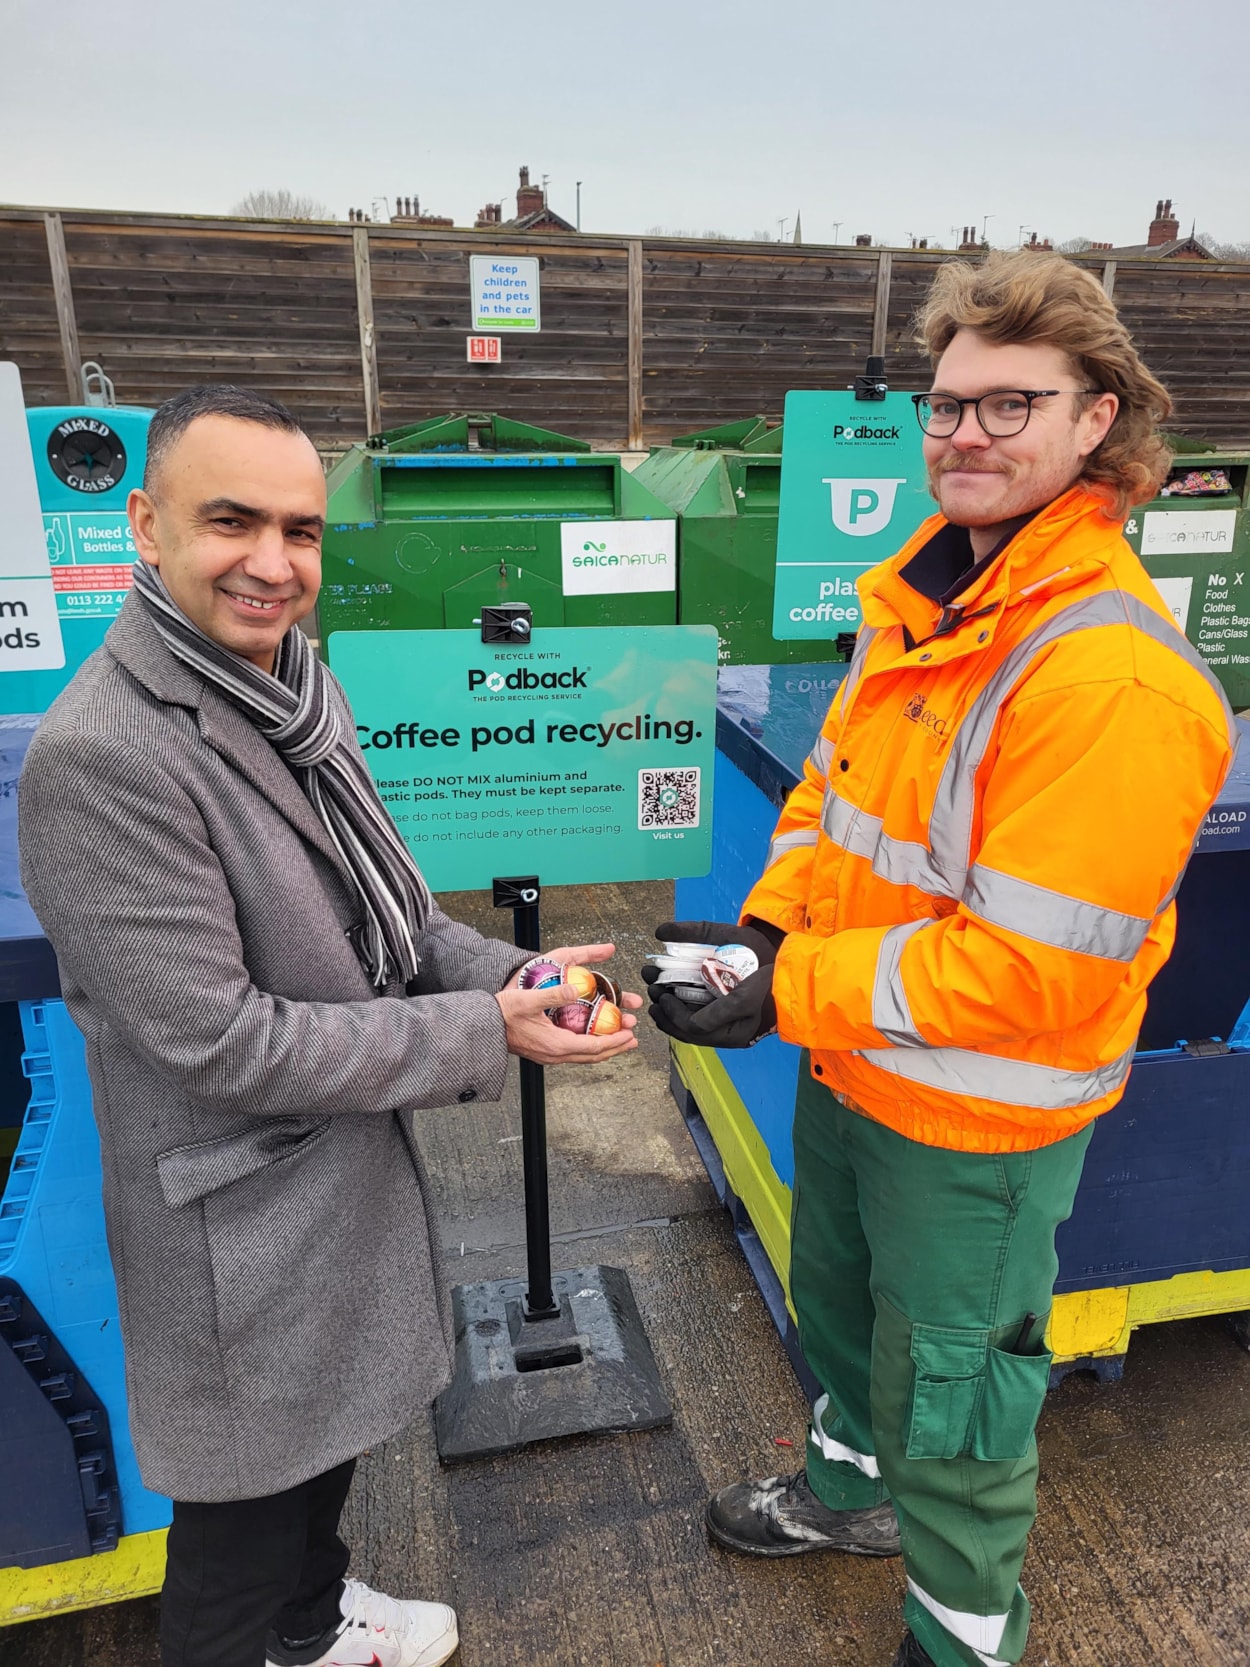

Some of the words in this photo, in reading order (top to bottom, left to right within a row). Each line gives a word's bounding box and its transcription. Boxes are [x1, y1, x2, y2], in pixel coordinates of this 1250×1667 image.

[492, 264, 518, 275] Keep
[484, 278, 527, 287] children
[482, 291, 501, 300] and
[506, 292, 530, 302] pets
[480, 304, 490, 313] in
[494, 304, 512, 314] the
[58, 418, 110, 438] MIXED
[834, 425, 900, 440] Podback
[67, 474, 115, 491] GLASS
[78, 526, 122, 540] Mixed
[83, 541, 124, 552] Bottles
[1208, 574, 1227, 586] No
[66, 595, 92, 605] 0113
[94, 594, 114, 604] 222
[1205, 590, 1228, 599] Food
[789, 603, 859, 621] coffee
[1203, 603, 1236, 613] Clothes
[1201, 616, 1229, 626] Plastic
[0, 627, 41, 649] ds
[1199, 629, 1248, 639] Cans/Glass
[1196, 642, 1226, 652] Plastic
[494, 653, 534, 661] RECYCLE
[537, 652, 561, 660] WITH
[1204, 655, 1229, 664] eneral
[1231, 654, 1250, 664] Was
[468, 666, 588, 692] Podback
[356, 722, 460, 750] Coffee
[471, 718, 535, 752] pod
[547, 714, 703, 747] recycling.
[376, 778, 409, 789] lease
[413, 777, 433, 787] DO
[437, 776, 464, 786] NOT
[467, 774, 491, 785] MIX
[494, 772, 561, 784] aluminium
[564, 771, 588, 781] and
[381, 791, 411, 802] astic
[414, 790, 448, 802] pods.
[451, 789, 482, 800] They
[485, 787, 517, 798] must
[521, 786, 536, 796] be
[540, 784, 567, 796] kept
[570, 783, 625, 794] separate.
[412, 812, 428, 821] do
[432, 811, 452, 820] not
[455, 810, 478, 820] bag
[481, 808, 513, 819] pods,
[516, 806, 545, 817] keep
[547, 804, 579, 815] them
[582, 803, 614, 814] loose.
[1205, 812, 1247, 824] ALOAD
[413, 831, 429, 842] do
[432, 831, 452, 841] not
[455, 829, 500, 840] include
[502, 828, 523, 839] any
[526, 825, 558, 836] other
[561, 823, 624, 836] packaging.
[652, 832, 672, 840] Visit
[1201, 826, 1240, 835] oad.com
